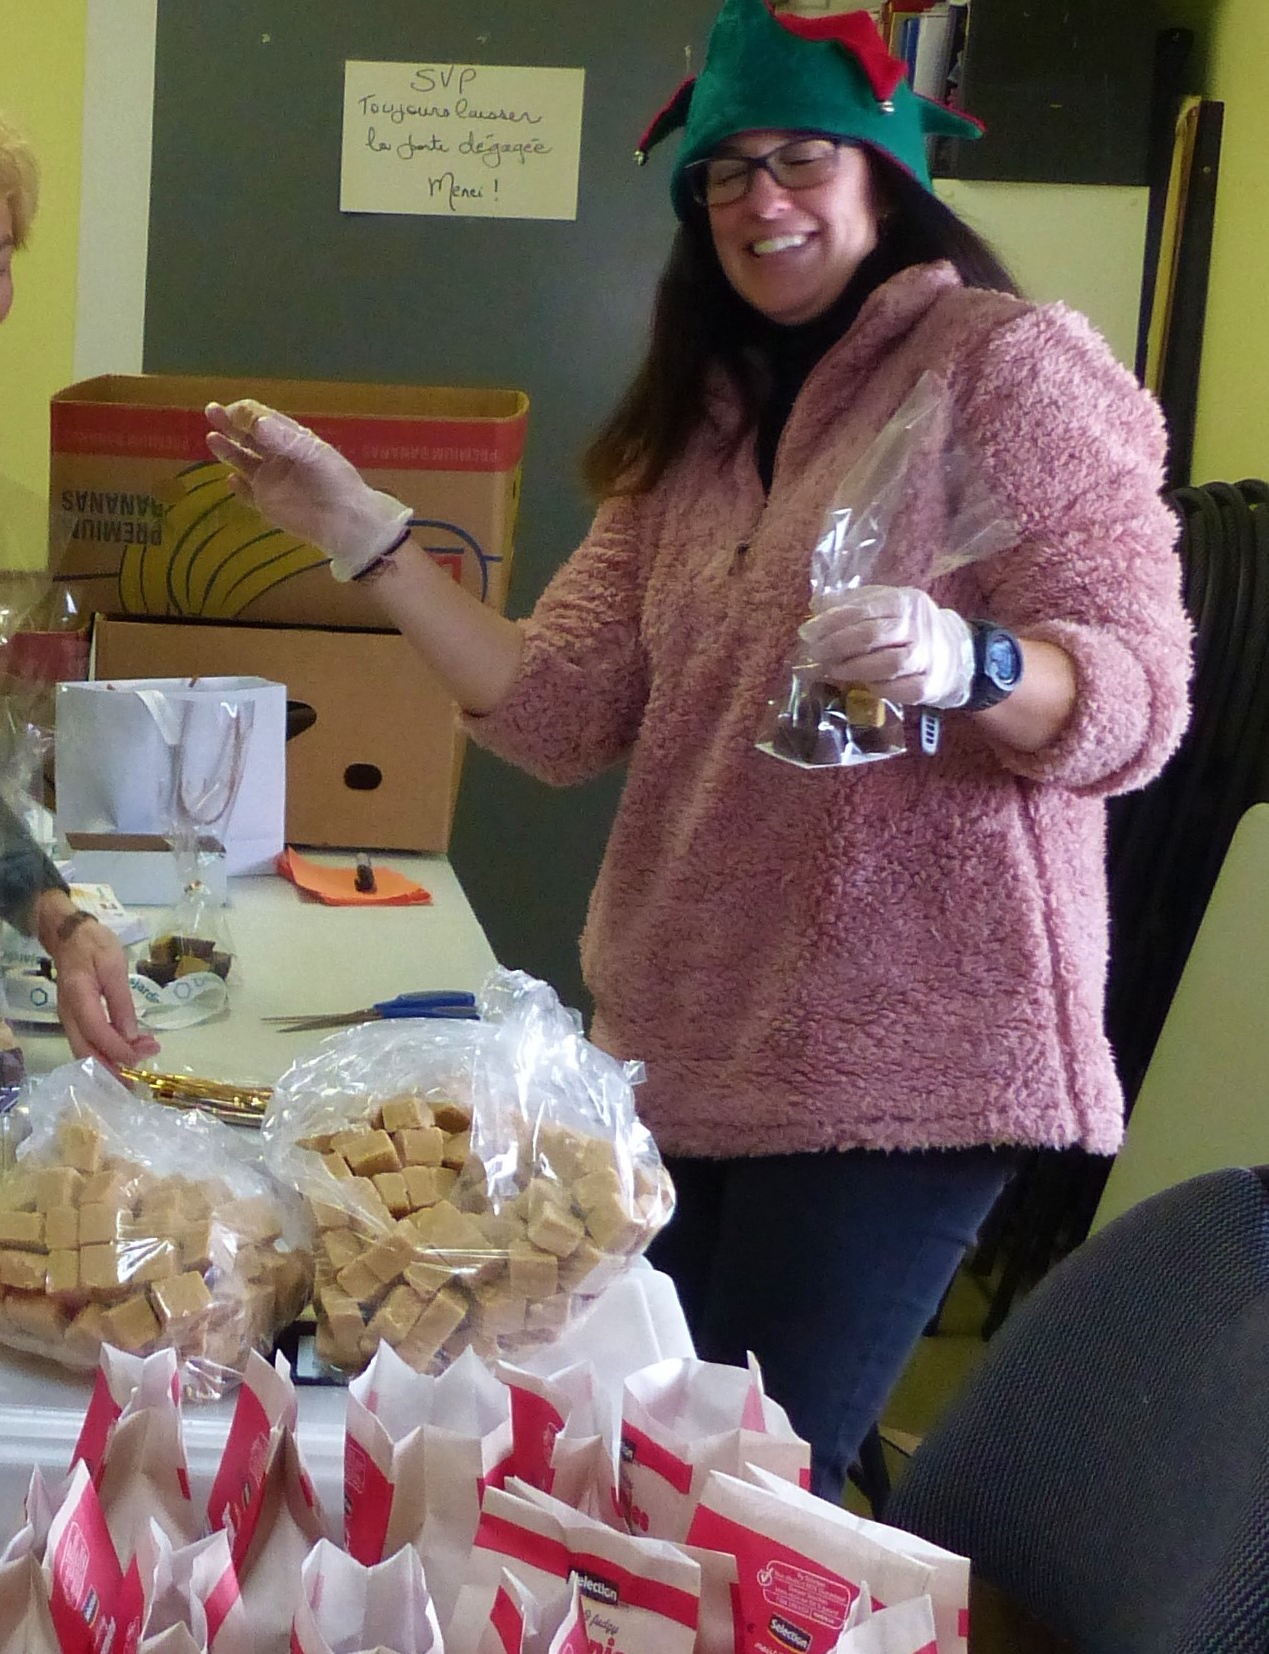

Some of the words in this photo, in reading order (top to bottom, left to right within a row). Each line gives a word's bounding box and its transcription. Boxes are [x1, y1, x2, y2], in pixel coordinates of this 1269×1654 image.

[410, 65, 476, 94] SVP
[358, 94, 450, 124] Toujours
[454, 98, 544, 124] laisser
[365, 127, 391, 151] la
[396, 134, 449, 160] porte
[576, 1574, 618, 1601] election
